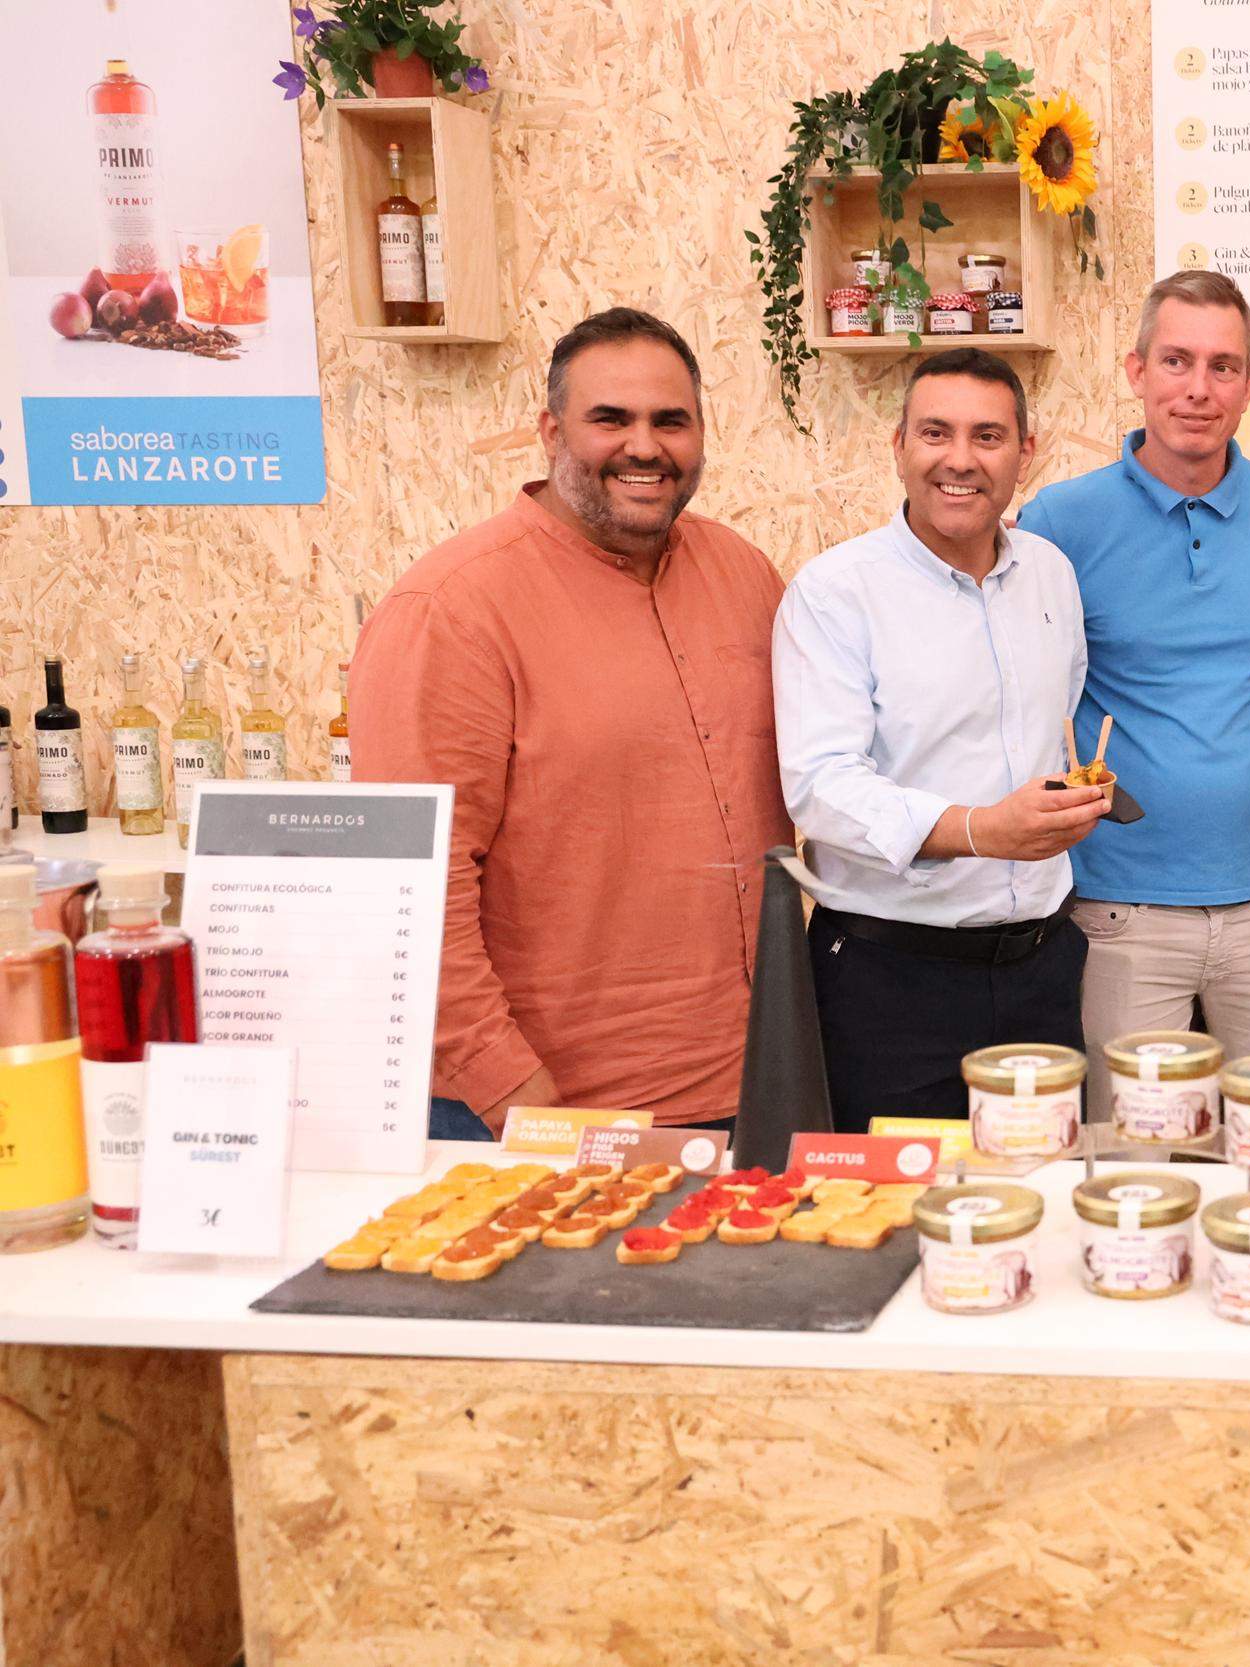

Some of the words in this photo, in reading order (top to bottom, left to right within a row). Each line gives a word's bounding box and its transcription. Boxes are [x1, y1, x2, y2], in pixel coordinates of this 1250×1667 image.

[1212, 47, 1249, 62] Papas
[1212, 62, 1242, 75] salsa
[1212, 78, 1246, 91] mojo
[1213, 139, 1229, 152] de
[99, 148, 154, 168] PRIMO
[107, 197, 153, 205] VERMUT
[1214, 204, 1237, 213] con
[1214, 246, 1237, 259] Gin
[1240, 247, 1250, 258] &
[71, 455, 282, 482] LANZAROTE
[269, 814, 365, 826] BERNARDOS
[212, 883, 270, 892] CONFITURA
[210, 904, 275, 913] CONFITURAS
[208, 925, 239, 934] MOJO
[232, 946, 263, 956] MOJO
[230, 968, 289, 978] CONFITURA
[202, 989, 266, 998] ALMOGROTE
[203, 1032, 229, 1041] ICOR
[232, 1033, 274, 1042] GRANDE
[521, 1119, 572, 1132] PAPAYA
[173, 1132, 198, 1143] GIN
[201, 1132, 210, 1143] &
[215, 1133, 259, 1145] TONIC
[519, 1131, 577, 1144] ORANGE
[594, 1131, 640, 1145] HIGOS
[805, 1152, 866, 1165] CACTUS
